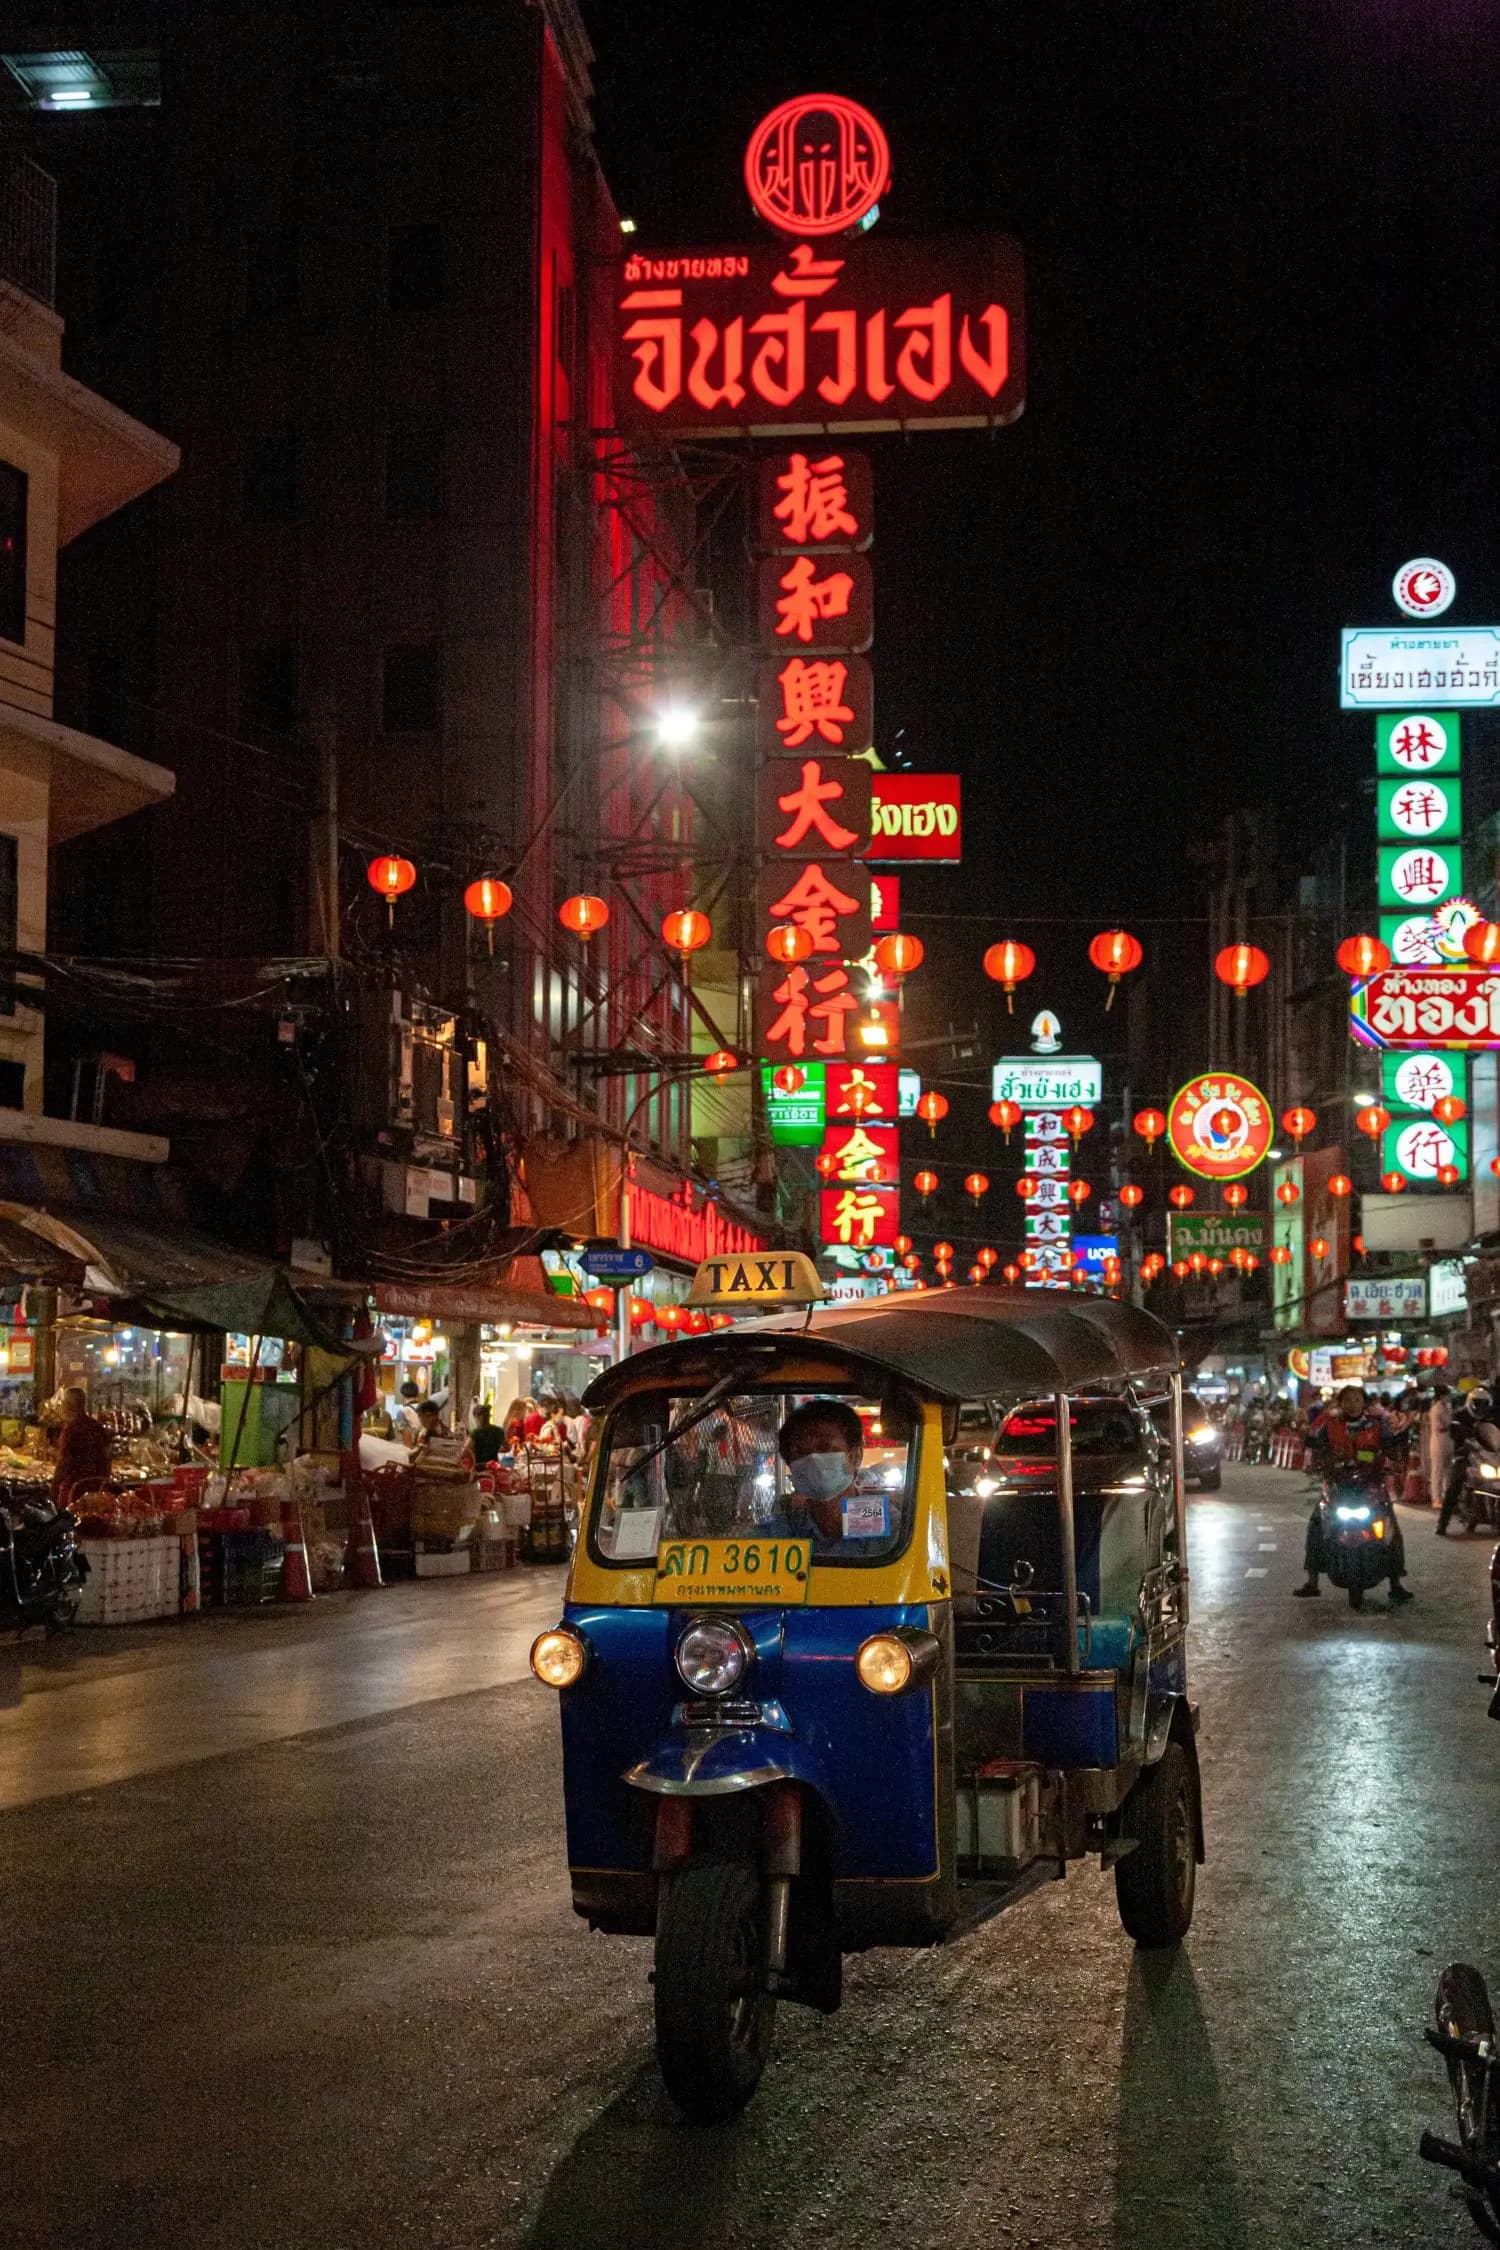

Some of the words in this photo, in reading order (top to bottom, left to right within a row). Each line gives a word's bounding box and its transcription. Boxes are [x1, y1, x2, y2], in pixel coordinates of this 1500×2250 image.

[624, 253, 749, 282] ห้างขายทอง
[1382, 971, 1468, 995] ห้างทอง
[706, 1260, 796, 1294] TAXI
[723, 1543, 803, 1575] 3610
[677, 1584, 782, 1599] กรุงเทพมหานคร
